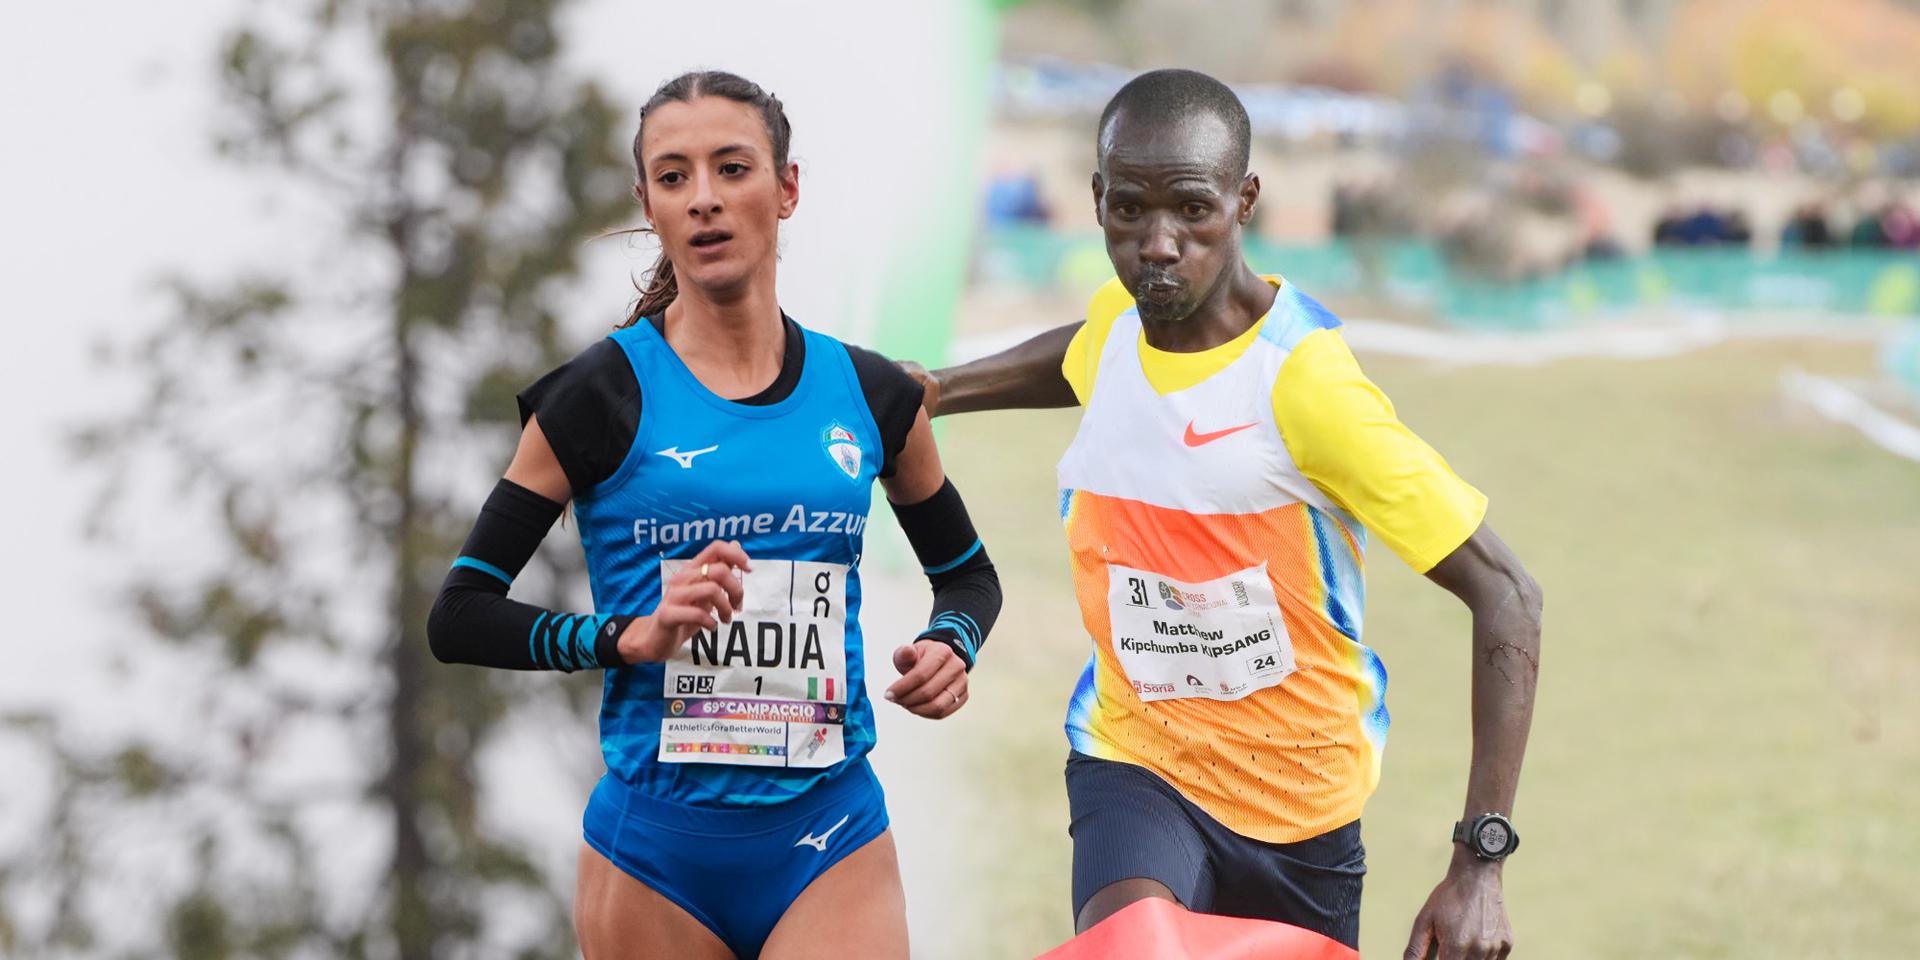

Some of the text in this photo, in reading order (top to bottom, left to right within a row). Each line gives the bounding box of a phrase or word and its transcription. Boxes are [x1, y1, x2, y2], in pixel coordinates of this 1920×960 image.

[634, 512, 774, 545] Fiamme
[1129, 577, 1149, 606] 31
[1153, 620, 1224, 641] Matthew
[690, 621, 825, 670] NADIA
[1121, 638, 1198, 655] Kipchumba
[1254, 655, 1275, 670] 24
[754, 676, 763, 695] 1
[1143, 682, 1176, 694] Soria
[668, 723, 782, 735] #AthleticsforaBetterWorld
